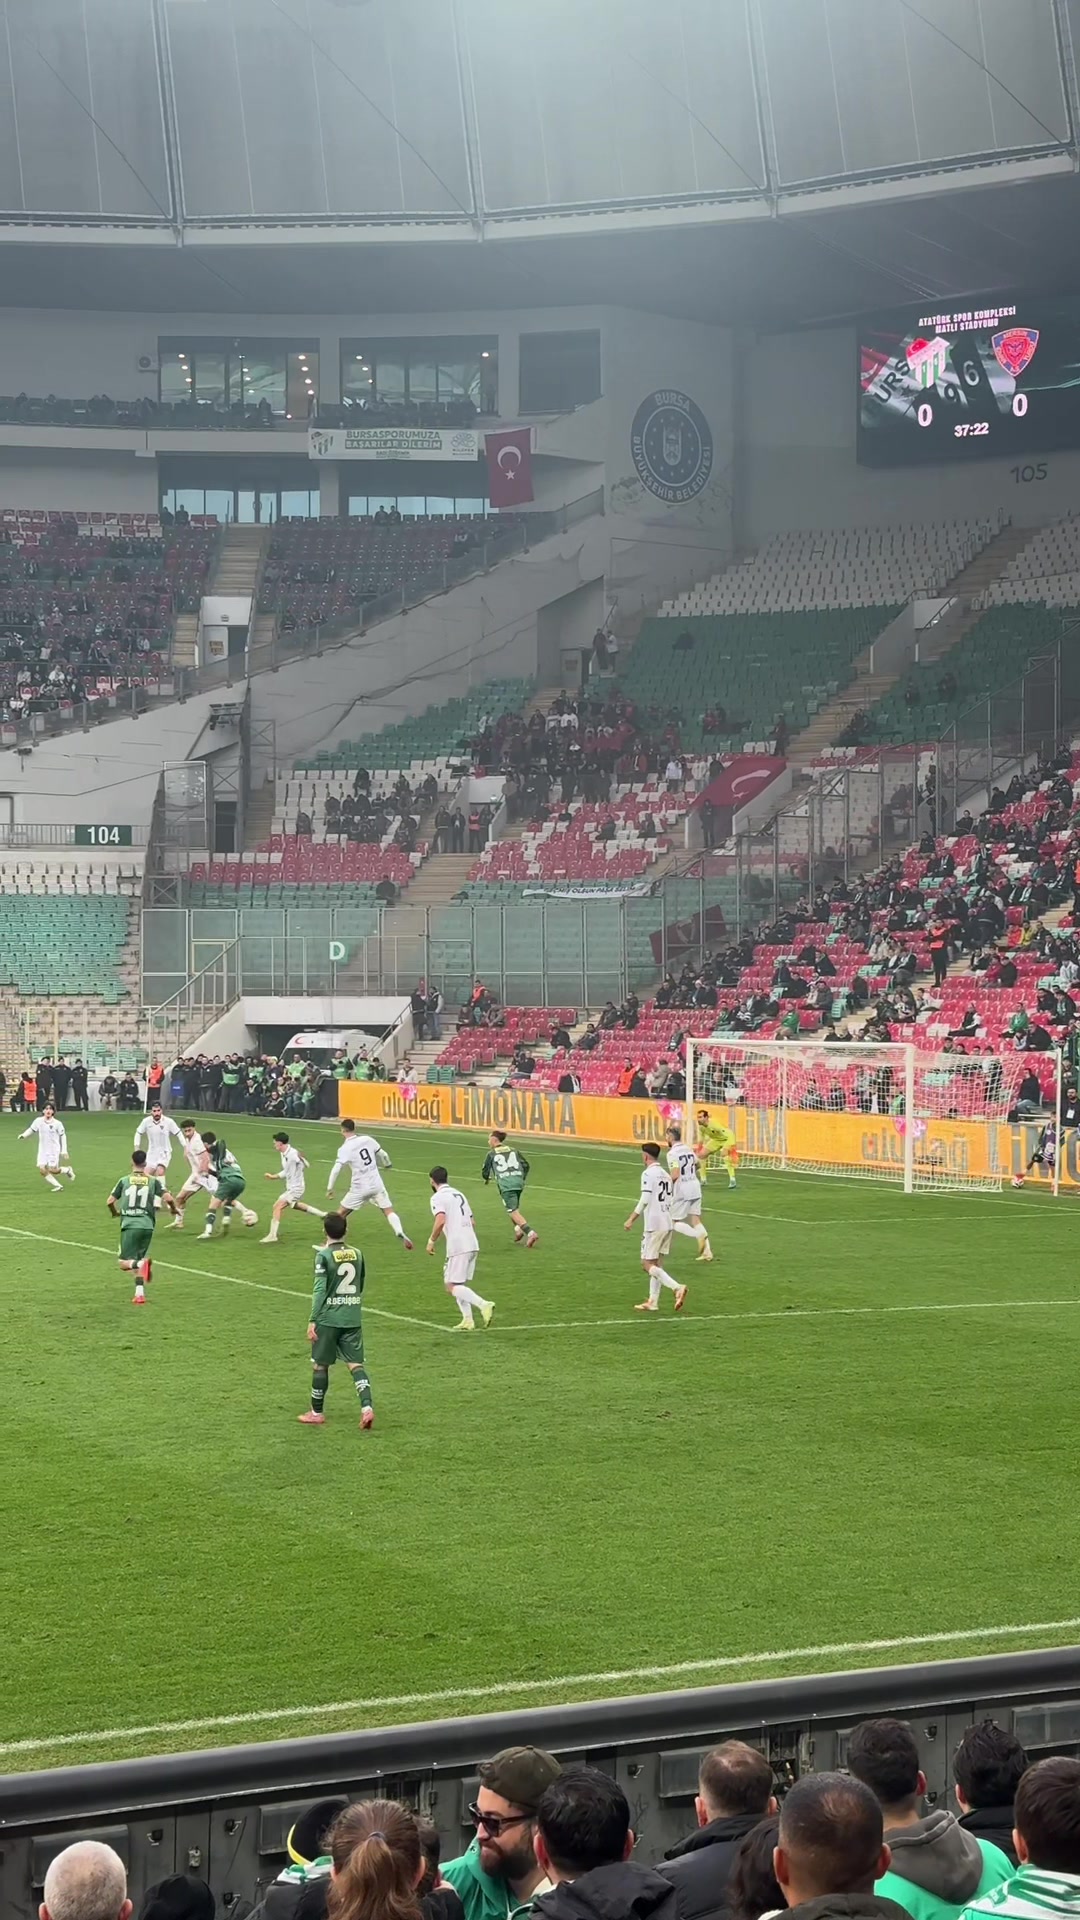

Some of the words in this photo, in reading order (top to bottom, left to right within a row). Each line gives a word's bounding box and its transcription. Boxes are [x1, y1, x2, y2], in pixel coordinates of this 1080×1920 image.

[953, 311, 972, 323] SPOR
[654, 391, 691, 412] BURSA
[1012, 393, 1028, 417] 0
[917, 403, 933, 427] 0
[346, 430, 441, 439] BURSASPORUMUZA
[954, 422, 989, 438] 37:22
[346, 440, 399, 449] BAŞARILAR
[1010, 462, 1048, 484] 105
[87, 826, 120, 844] 104
[329, 941, 346, 960] D
[382, 1089, 441, 1124] uludağ
[359, 1148, 373, 1166] 9
[493, 1151, 520, 1171] 34
[679, 1154, 696, 1175] 77
[125, 1184, 149, 1208] 11
[453, 1193, 466, 1216] 7
[336, 1262, 357, 1295] 2
